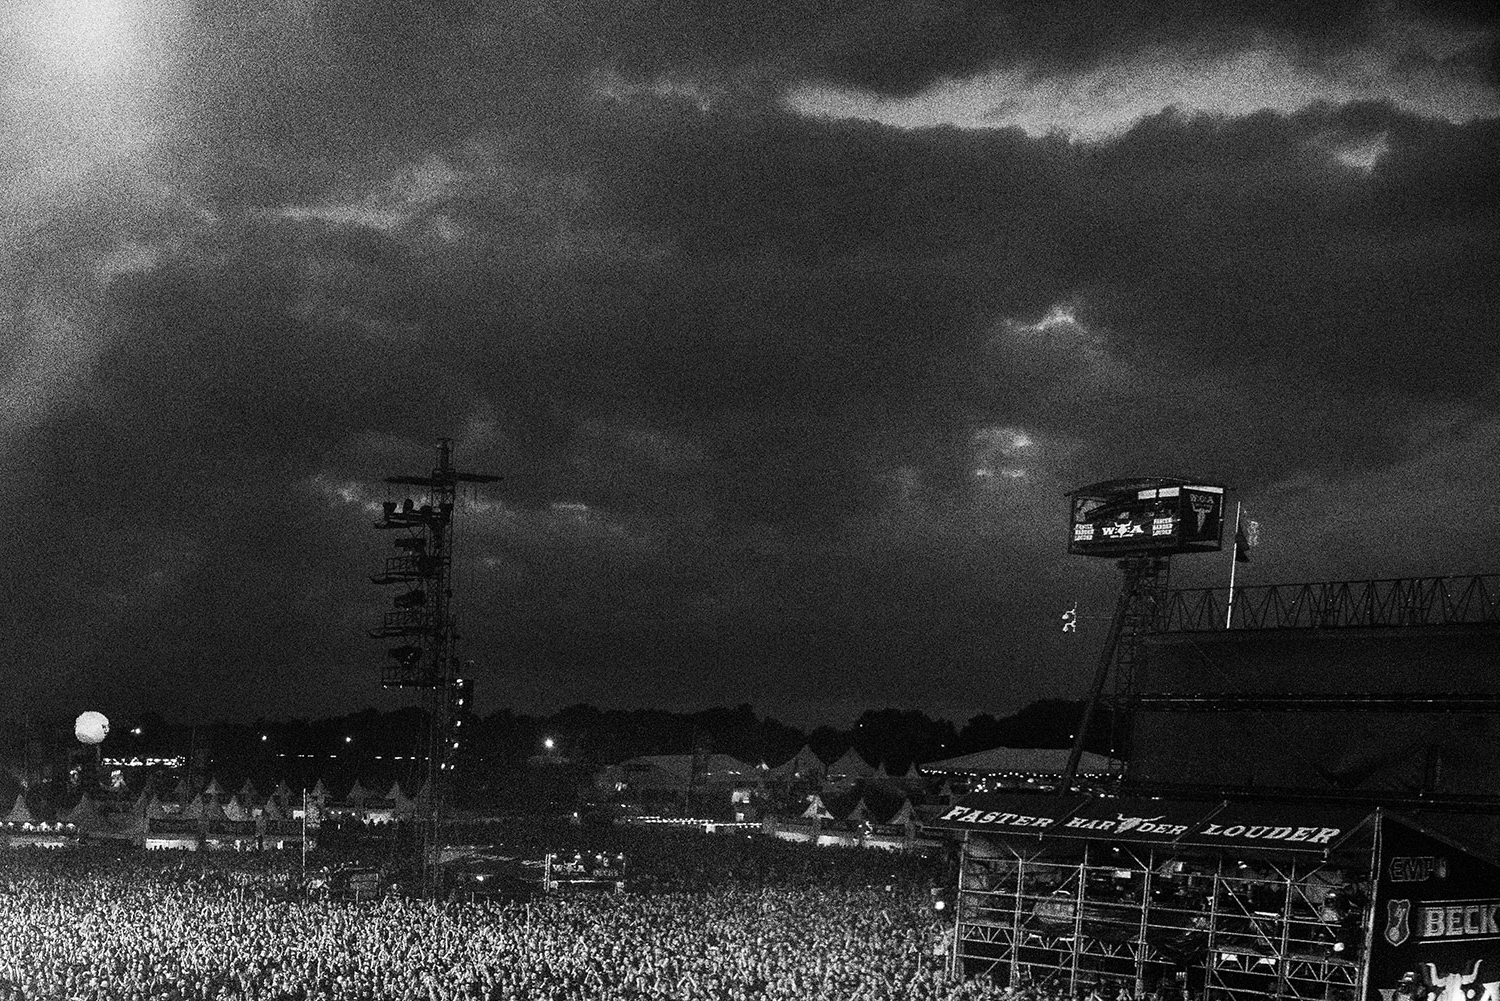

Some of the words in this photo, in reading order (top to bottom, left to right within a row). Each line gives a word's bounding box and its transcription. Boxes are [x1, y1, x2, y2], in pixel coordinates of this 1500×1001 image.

[941, 806, 1054, 827] FASTER
[1200, 824, 1340, 843] LOUDER
[1422, 904, 1500, 937] BECK
